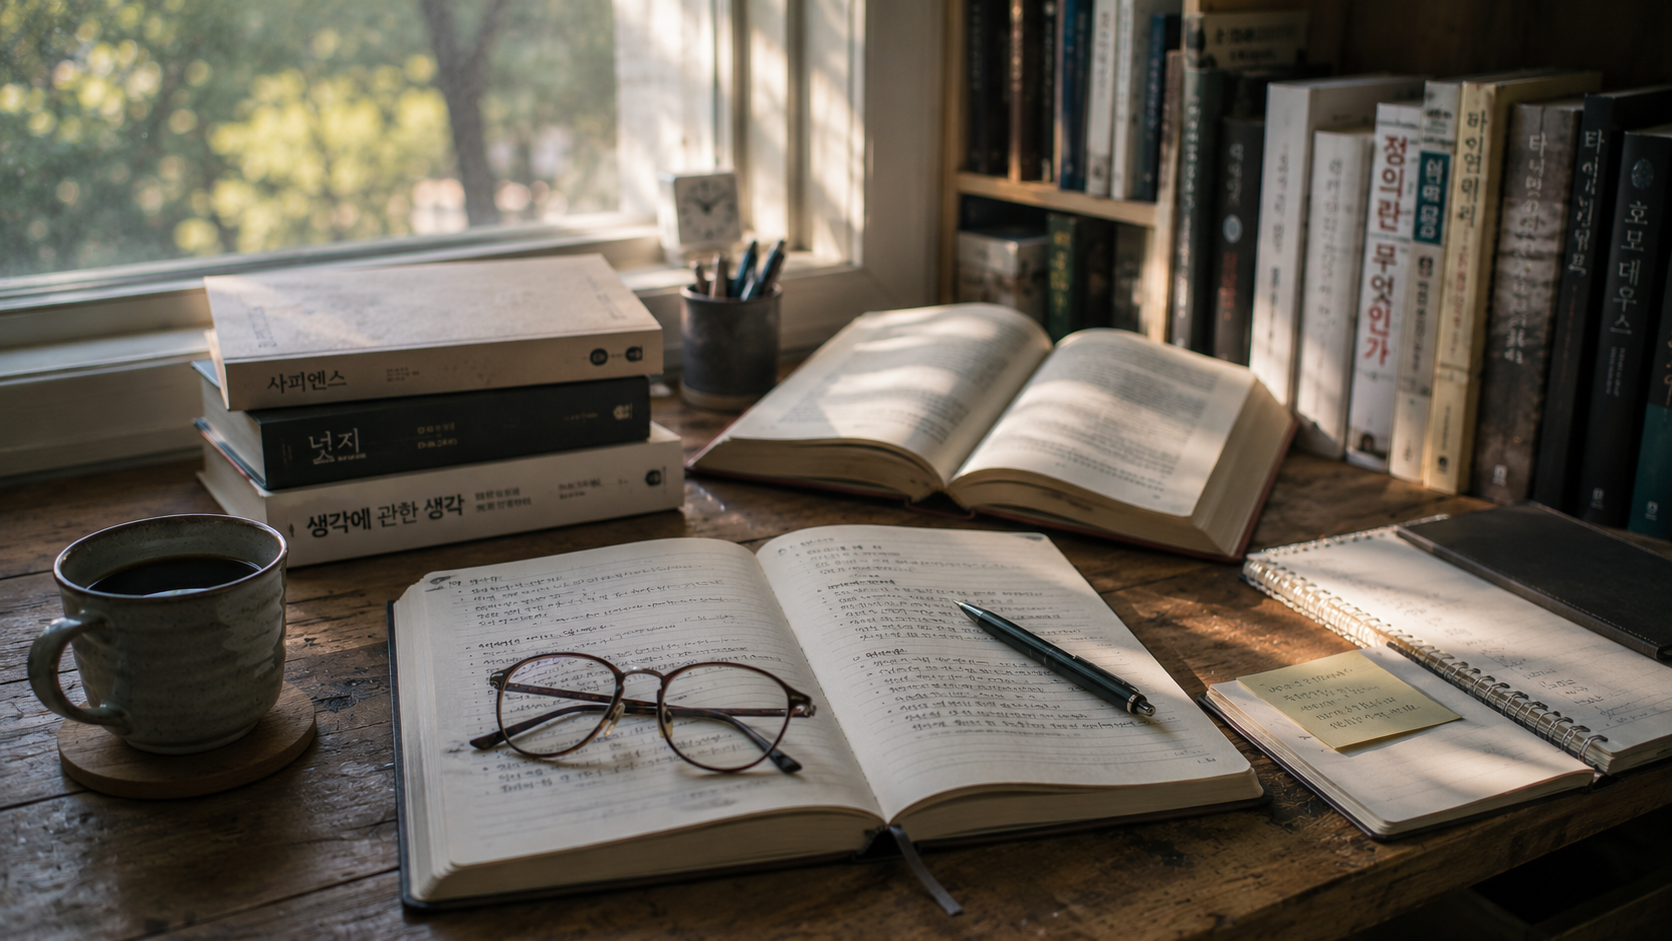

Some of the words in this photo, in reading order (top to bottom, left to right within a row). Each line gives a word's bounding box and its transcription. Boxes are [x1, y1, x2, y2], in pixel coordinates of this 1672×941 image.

[1378, 134, 1407, 232] 정의란
[1621, 200, 1648, 252] 호모
[1364, 243, 1397, 367] 무엇인가
[267, 370, 347, 394] 사피엔스
[308, 428, 360, 460] 넛지
[307, 507, 372, 538] 생각에
[377, 501, 419, 528] 관한
[424, 494, 465, 520] 생각
